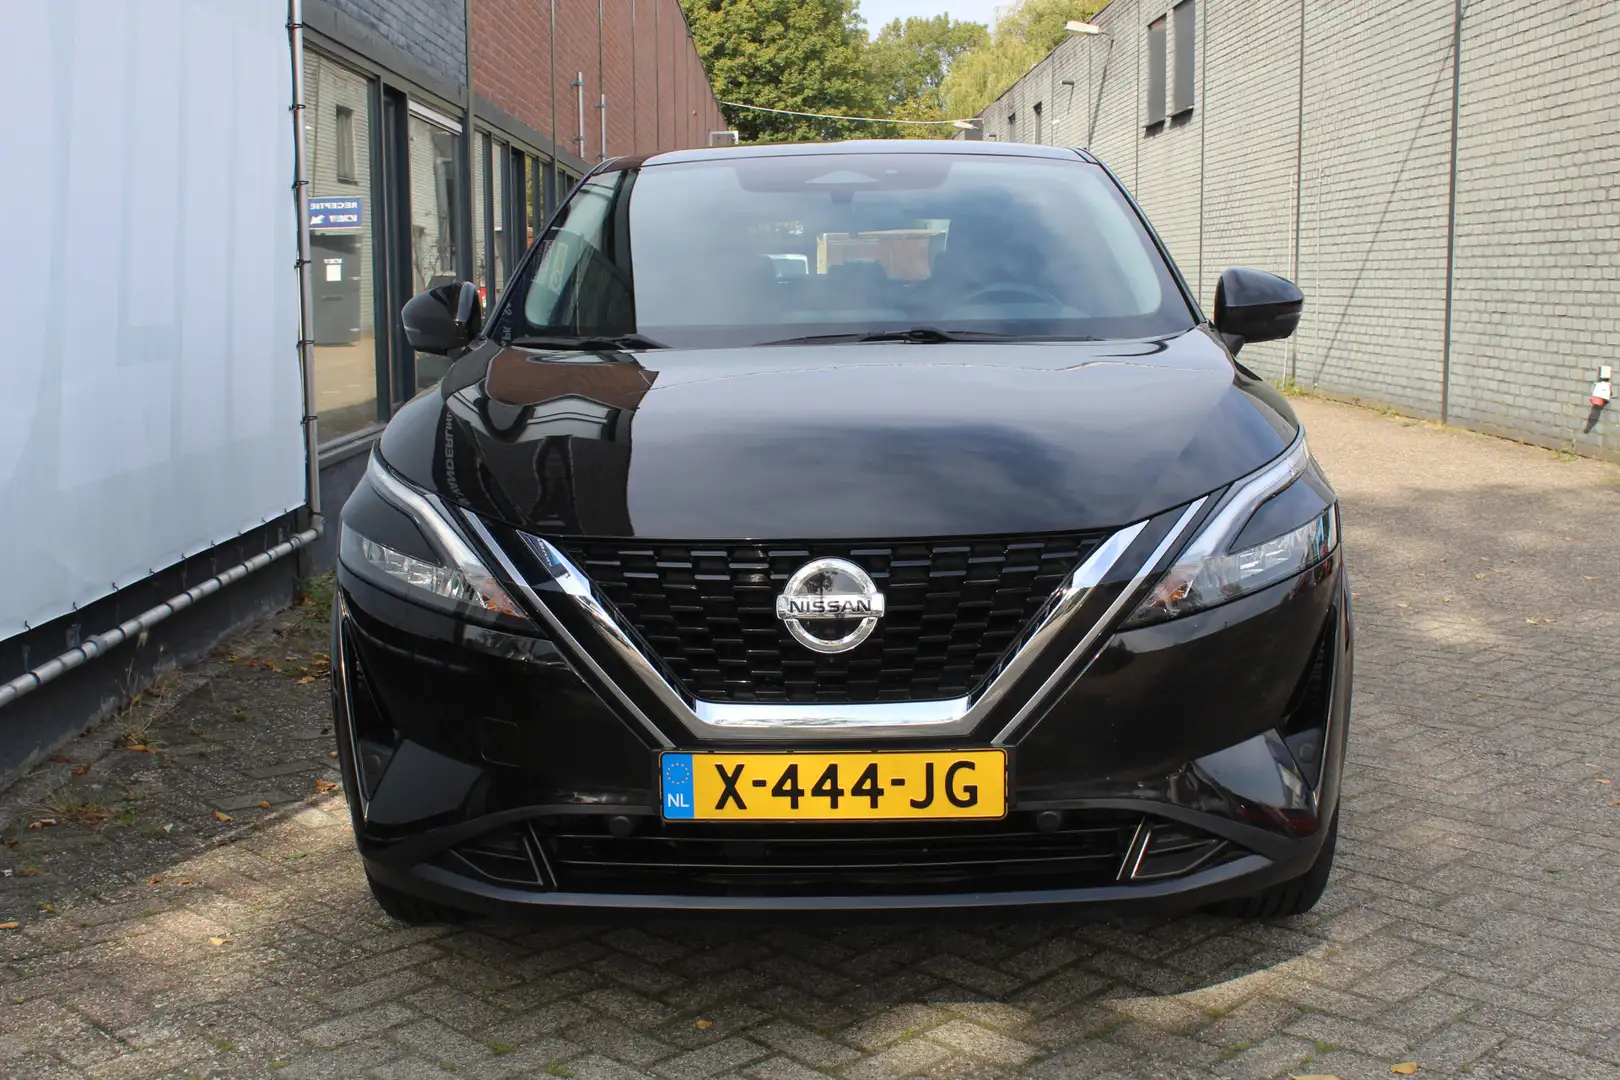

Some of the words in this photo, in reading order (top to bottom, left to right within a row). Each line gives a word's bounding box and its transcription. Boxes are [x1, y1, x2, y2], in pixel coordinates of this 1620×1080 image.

[789, 599, 872, 613] NISSAN
[714, 760, 979, 810] X-444-JG
[667, 793, 690, 808] NL
